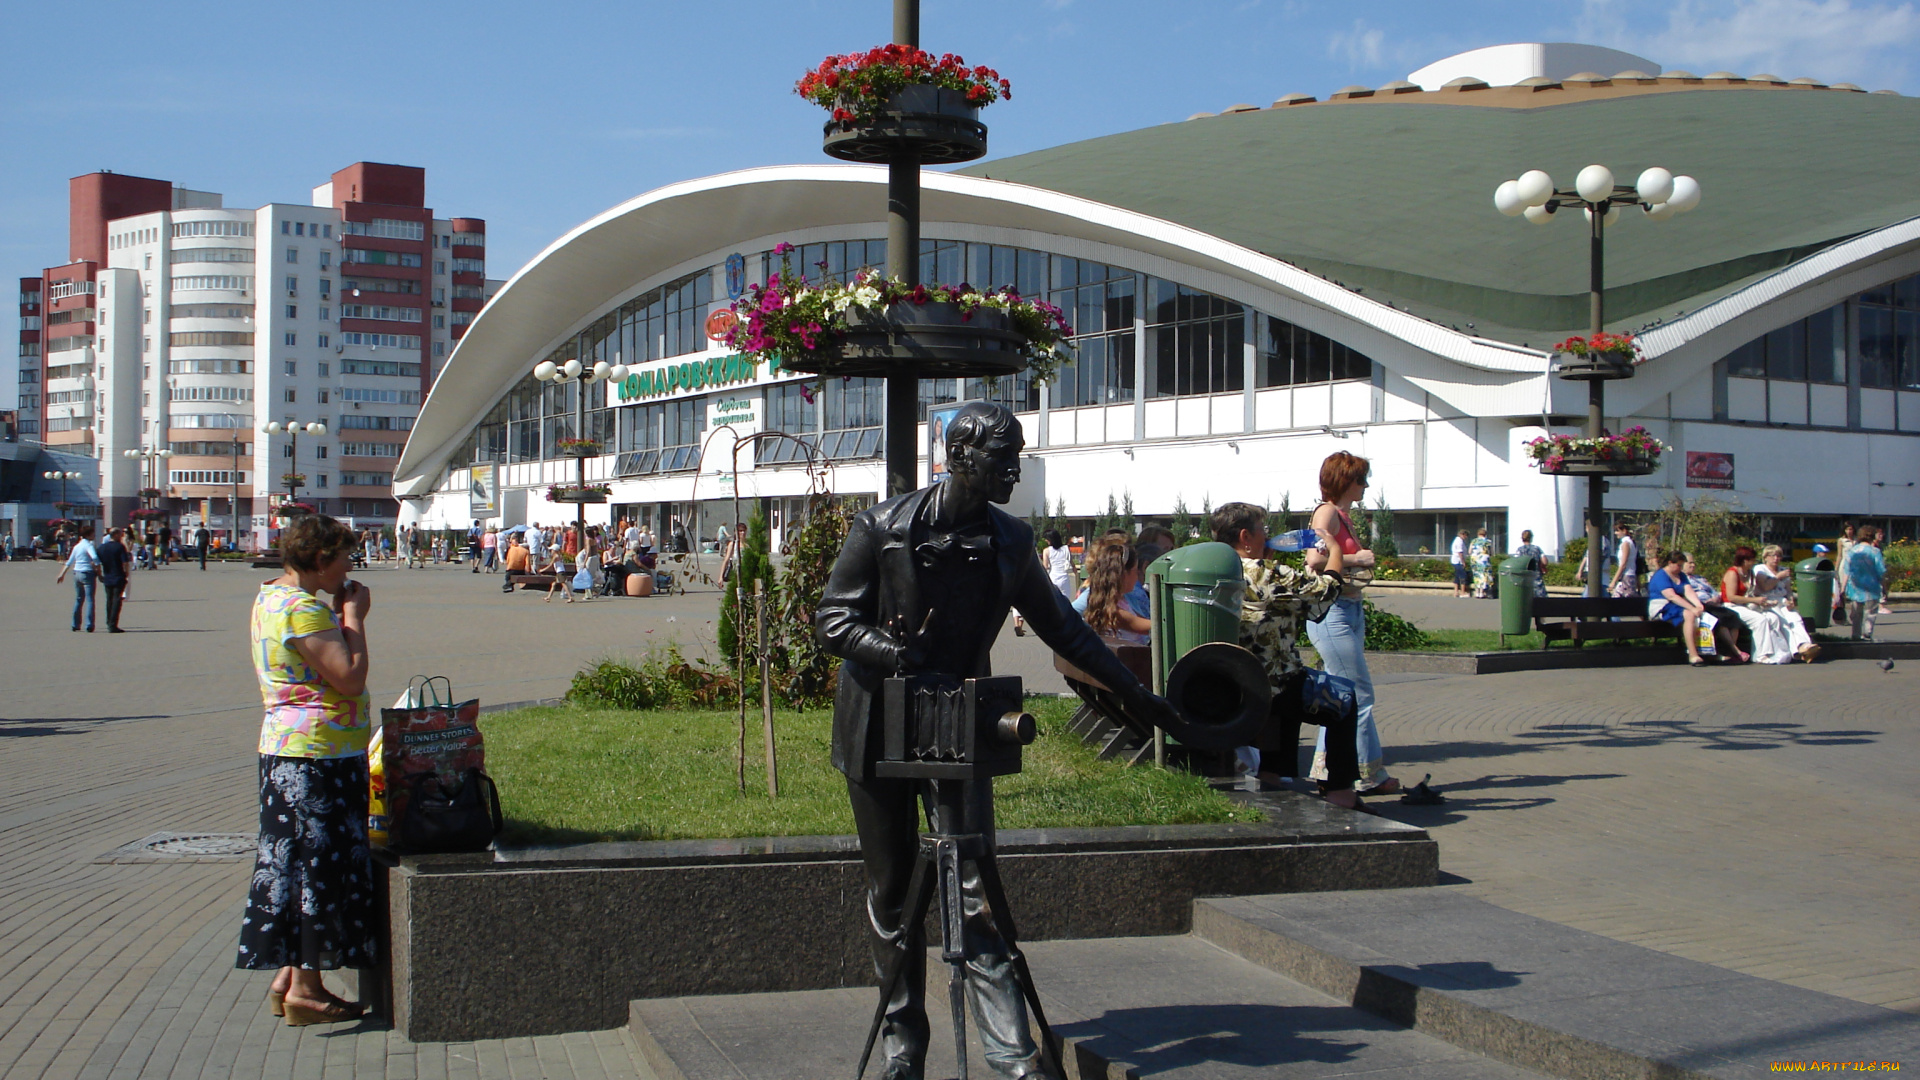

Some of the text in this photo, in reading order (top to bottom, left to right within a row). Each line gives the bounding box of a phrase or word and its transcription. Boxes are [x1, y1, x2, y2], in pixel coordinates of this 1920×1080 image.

[404, 728, 473, 743] DUNNES STORES
[441, 742, 468, 753] Value
